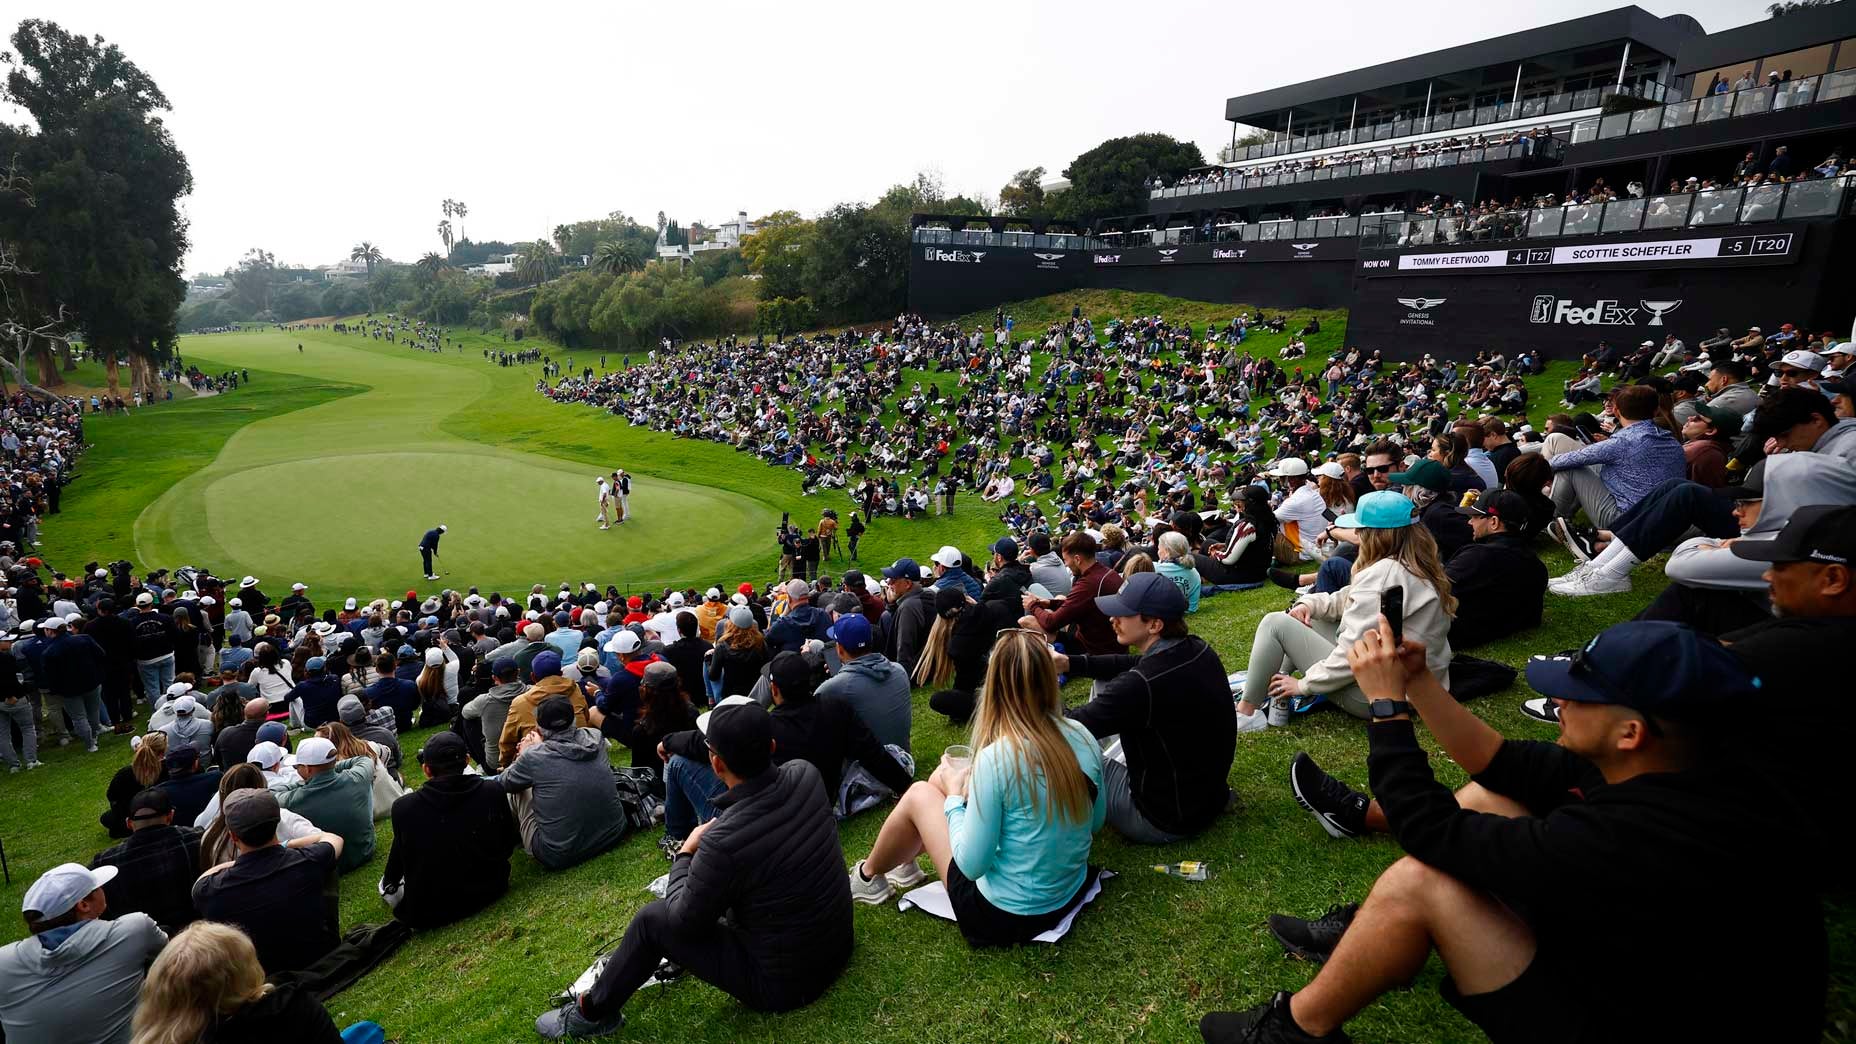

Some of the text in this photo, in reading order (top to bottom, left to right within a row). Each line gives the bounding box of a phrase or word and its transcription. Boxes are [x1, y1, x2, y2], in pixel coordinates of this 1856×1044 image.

[1727, 241, 1743, 252] -5
[1757, 239, 1786, 250] T20
[935, 250, 970, 262] FedEx
[1511, 253, 1521, 261] -4
[1530, 251, 1550, 261] T27
[1572, 244, 1693, 259] SCOTTIE SCHEFFLER
[1363, 260, 1390, 268] NOW ON
[1412, 255, 1490, 266] TOMMY FLEETWOOD
[1553, 300, 1638, 325] FedEx
